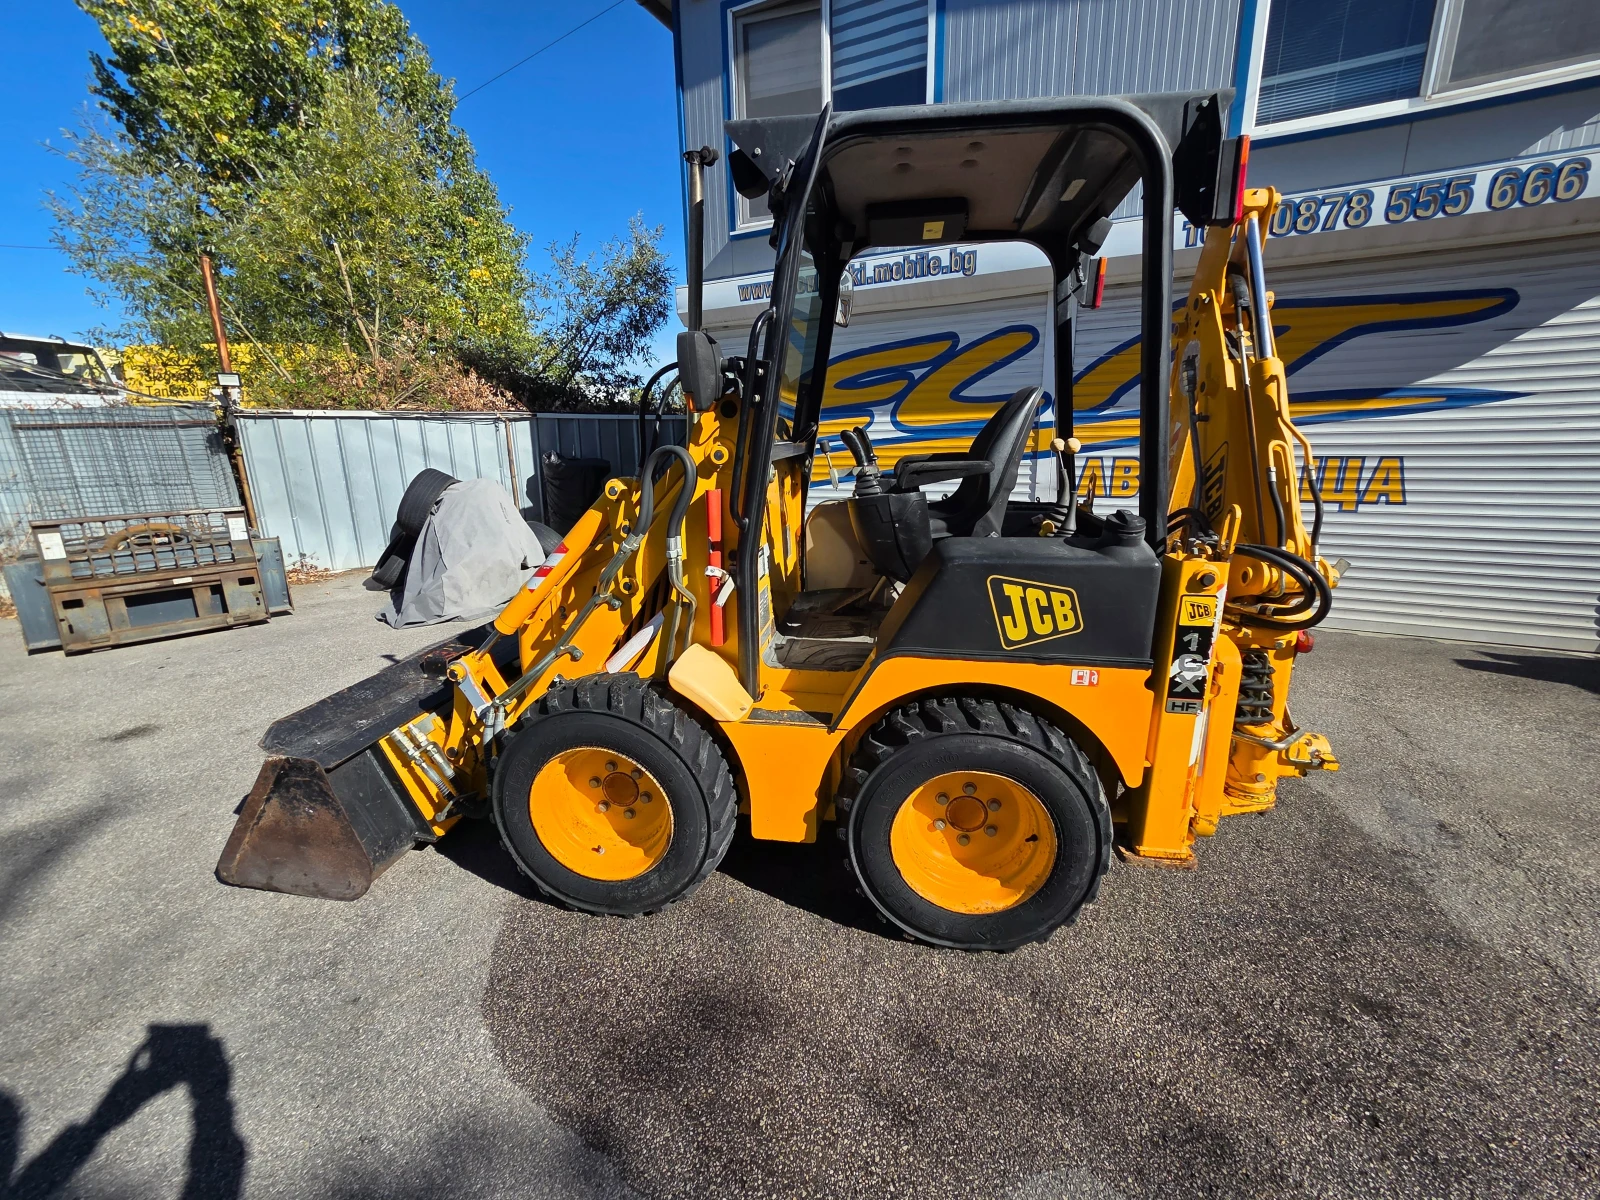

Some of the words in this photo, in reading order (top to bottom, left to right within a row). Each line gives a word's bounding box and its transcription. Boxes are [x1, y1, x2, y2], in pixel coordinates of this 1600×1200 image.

[1271, 190, 1375, 237] 0878
[1385, 173, 1477, 224] 555
[1486, 156, 1592, 211] 666
[1202, 455, 1226, 519] JCB
[1002, 583, 1076, 642] JCB
[1188, 603, 1211, 620] JCB
[1171, 701, 1198, 712] HF
